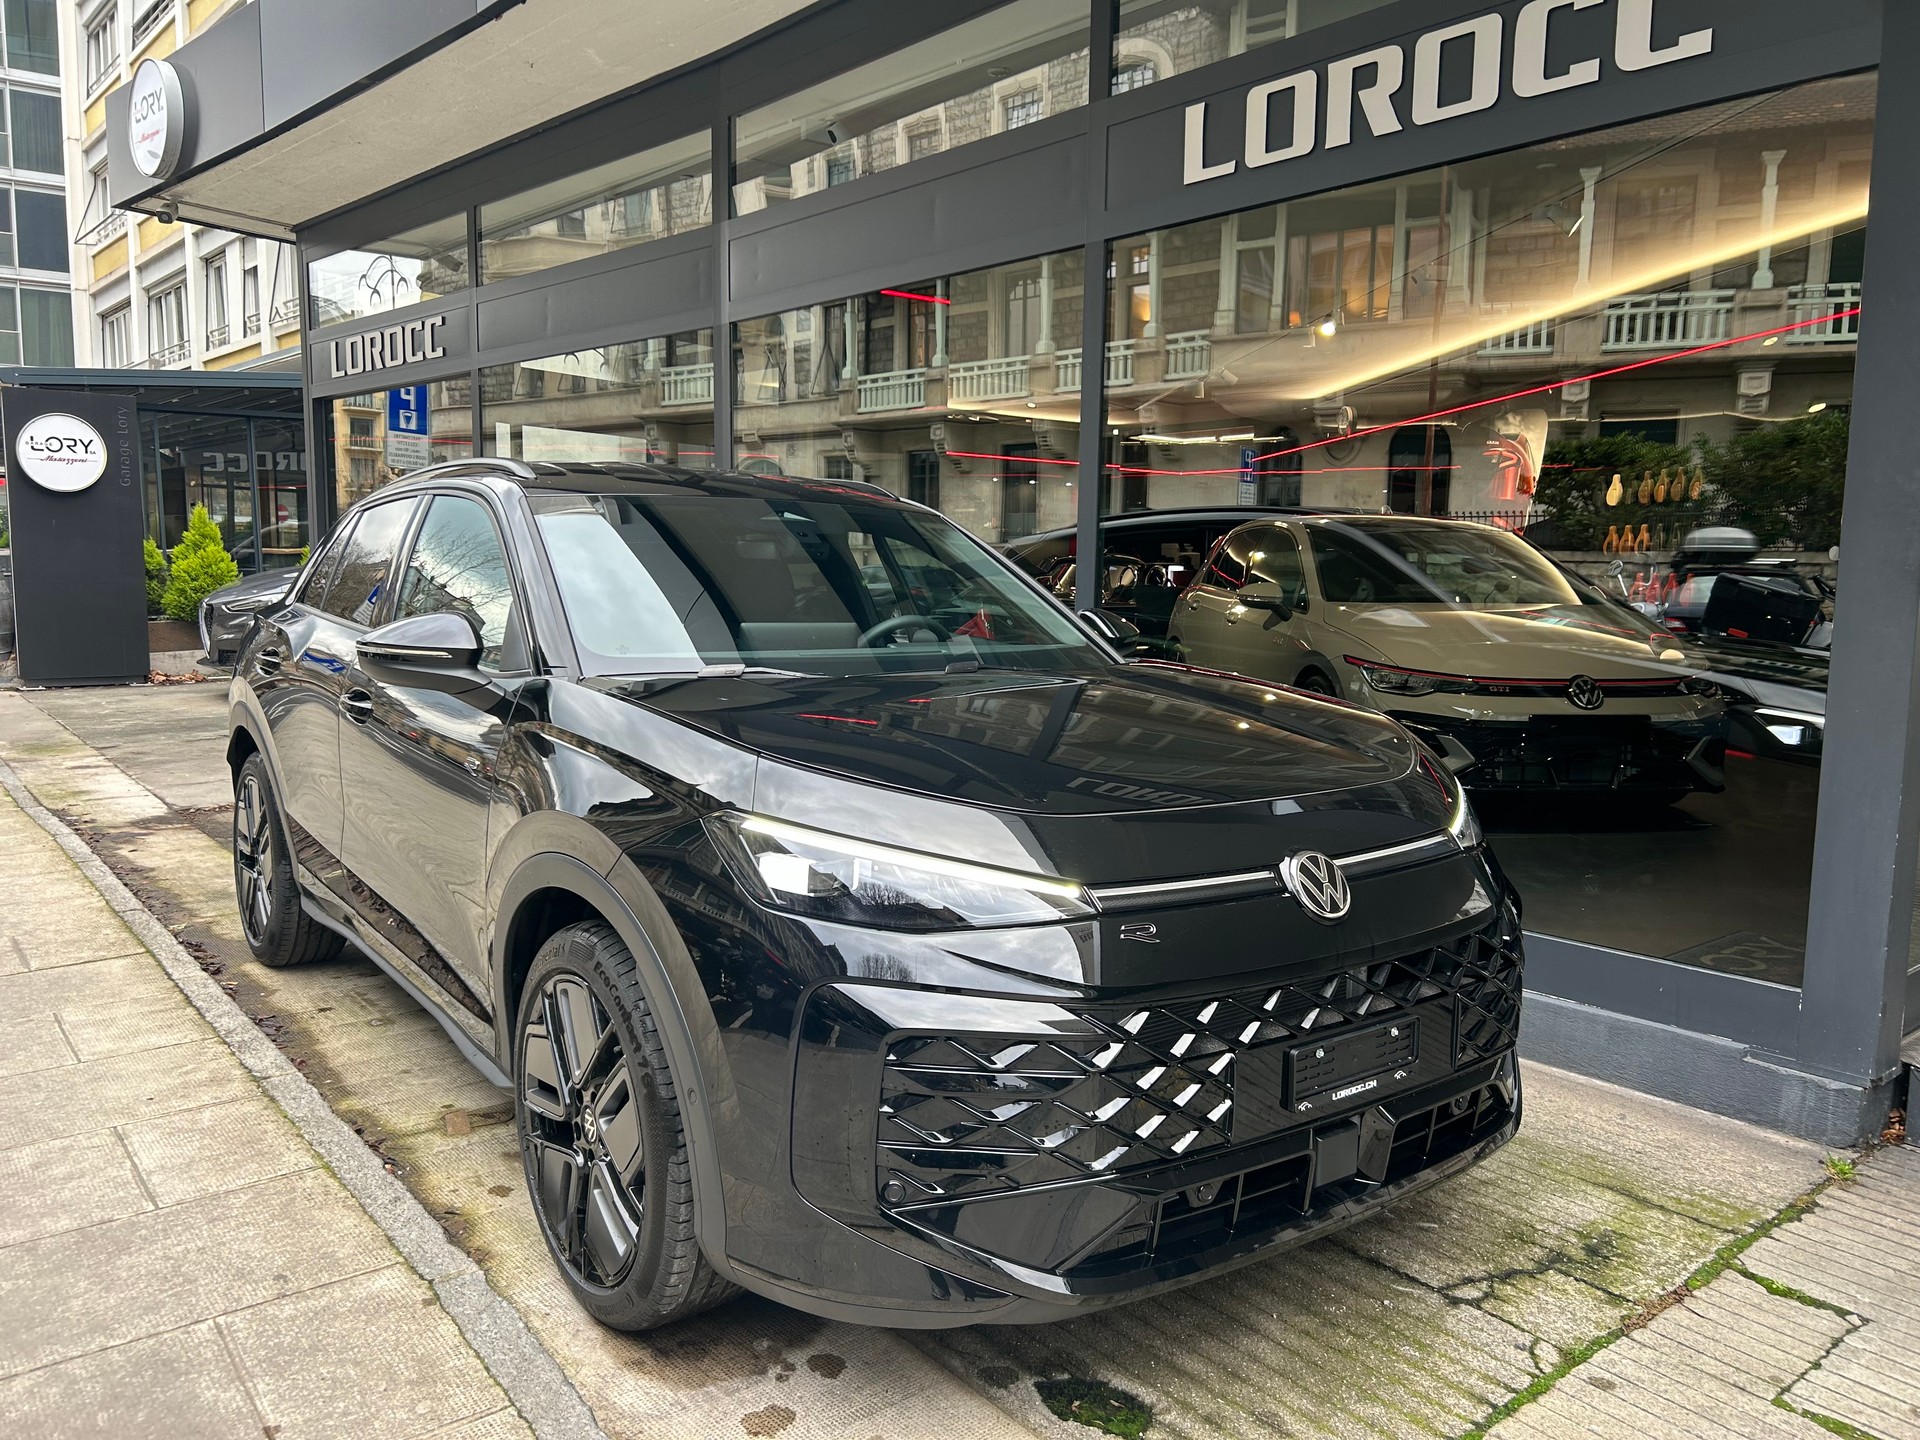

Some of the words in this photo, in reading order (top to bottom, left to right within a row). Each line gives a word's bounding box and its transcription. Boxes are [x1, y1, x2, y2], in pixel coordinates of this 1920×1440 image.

[133, 87, 162, 124] LORY
[330, 315, 444, 378] LOROCC
[117, 406, 129, 434] Lory
[30, 435, 94, 454] LORY
[120, 440, 132, 487] Garage
[1119, 922, 1161, 943] R
[1331, 1079, 1377, 1101] LOROCC.CH
